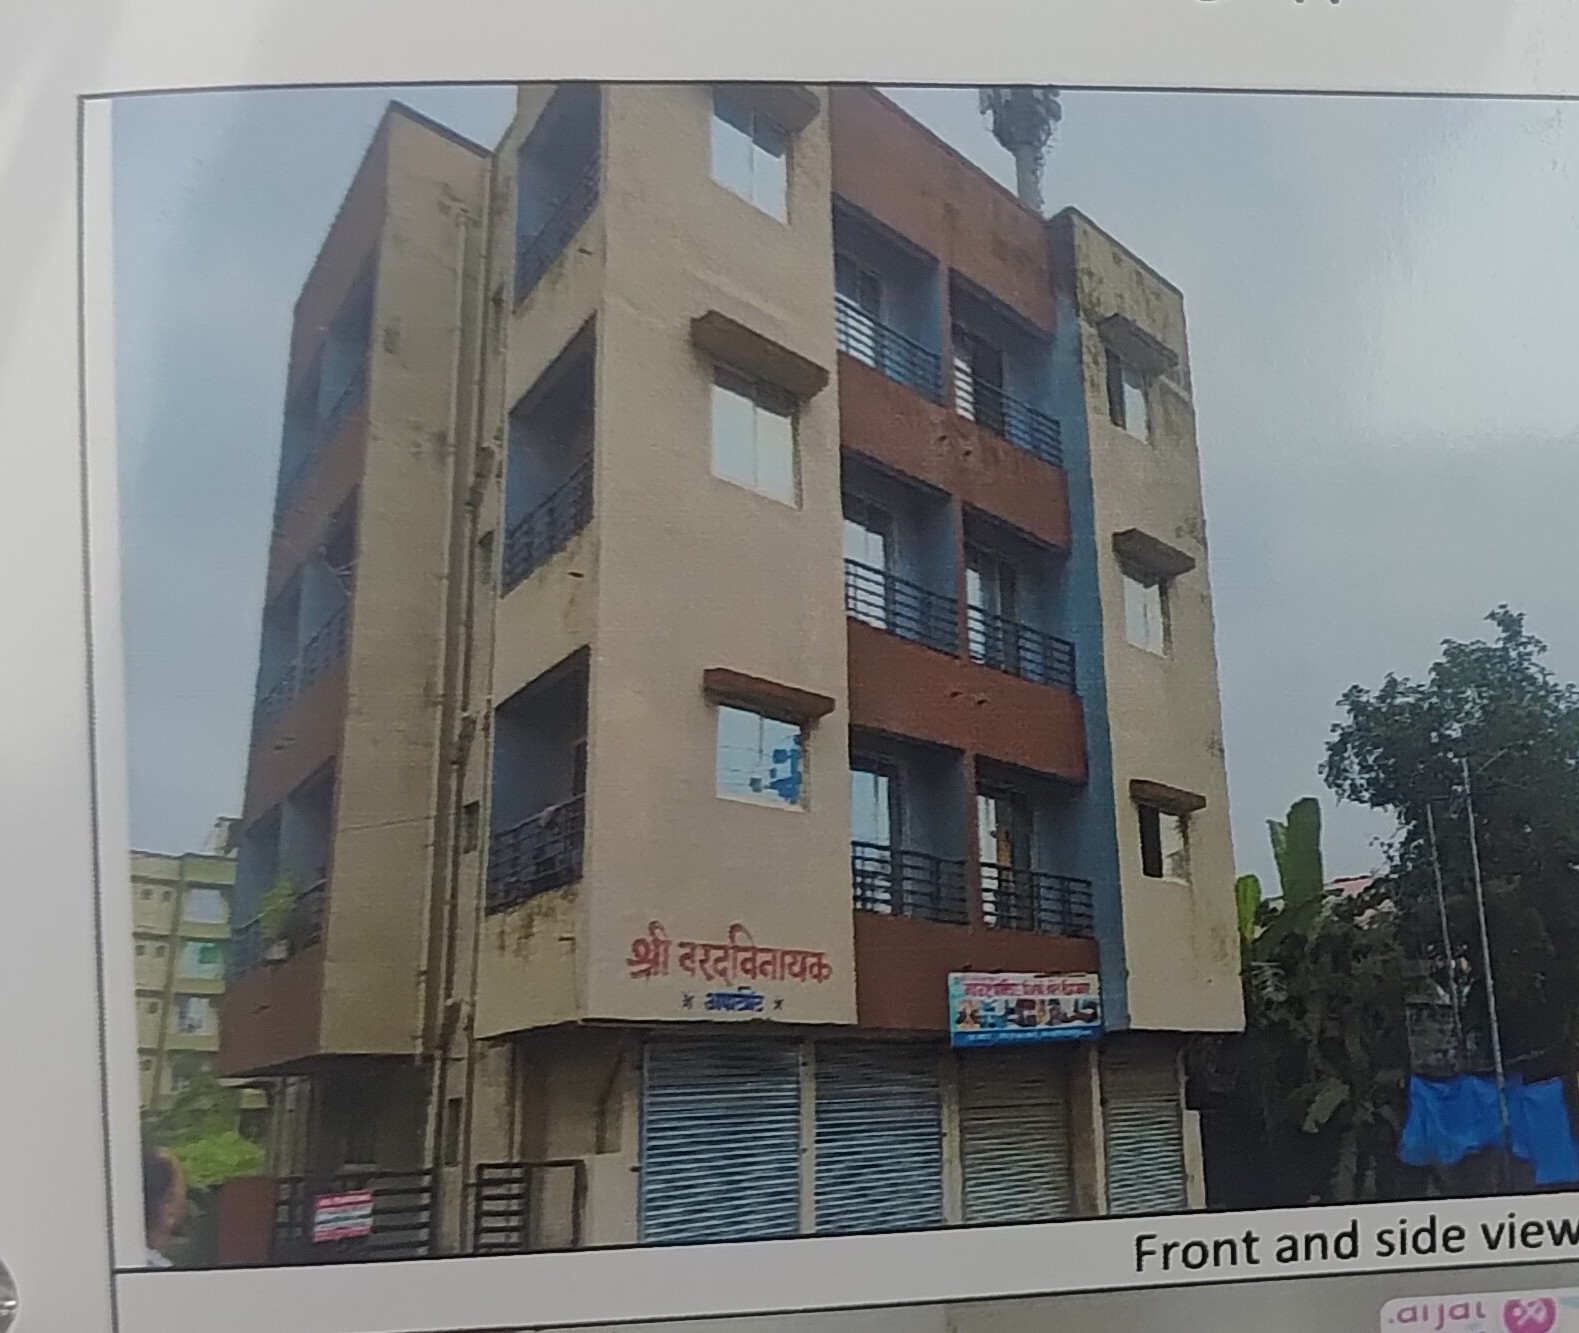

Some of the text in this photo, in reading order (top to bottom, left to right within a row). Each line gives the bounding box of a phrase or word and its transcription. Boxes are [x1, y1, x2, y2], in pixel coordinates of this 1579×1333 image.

[1135, 1230, 1260, 1272] Front
[1275, 1219, 1359, 1263] and
[1376, 1215, 1466, 1257] side
